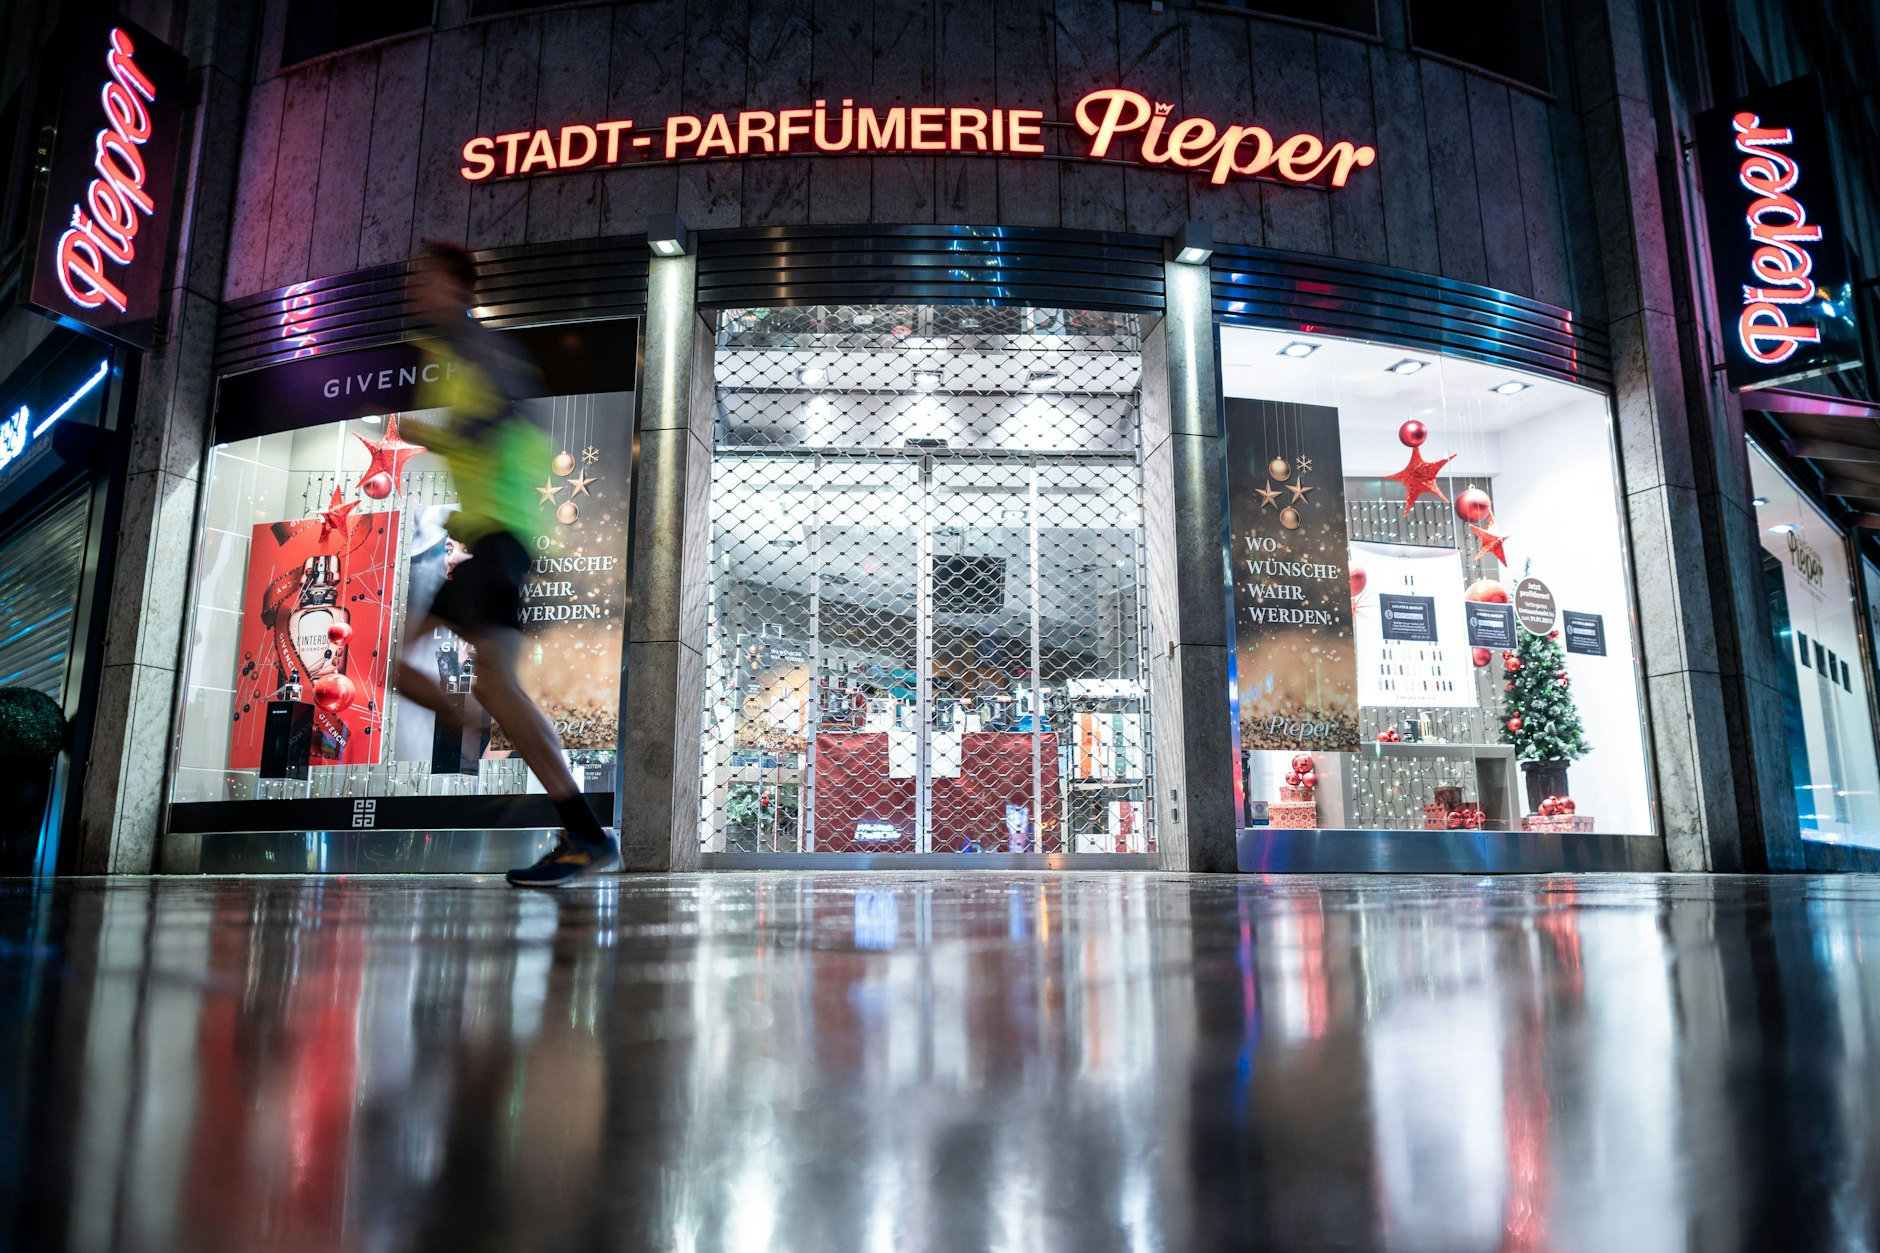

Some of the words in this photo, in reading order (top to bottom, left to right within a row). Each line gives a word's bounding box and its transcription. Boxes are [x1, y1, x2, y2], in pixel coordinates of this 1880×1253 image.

[1074, 87, 1377, 188] Pieper
[56, 27, 156, 313] Pieper
[1731, 111, 1823, 365] Pieper
[323, 363, 459, 399] GIVENCH
[1244, 536, 1277, 552] WO
[528, 555, 613, 574] ÜNSCHE
[1246, 557, 1338, 579] WÜNSCHE
[1786, 529, 1824, 588] Pieper
[1247, 583, 1304, 600] WAHR
[1527, 582, 1542, 591] Jetzt
[280, 633, 298, 671] GIVENC
[297, 635, 329, 647] L'INTERD
[1265, 715, 1336, 742] Pieper
